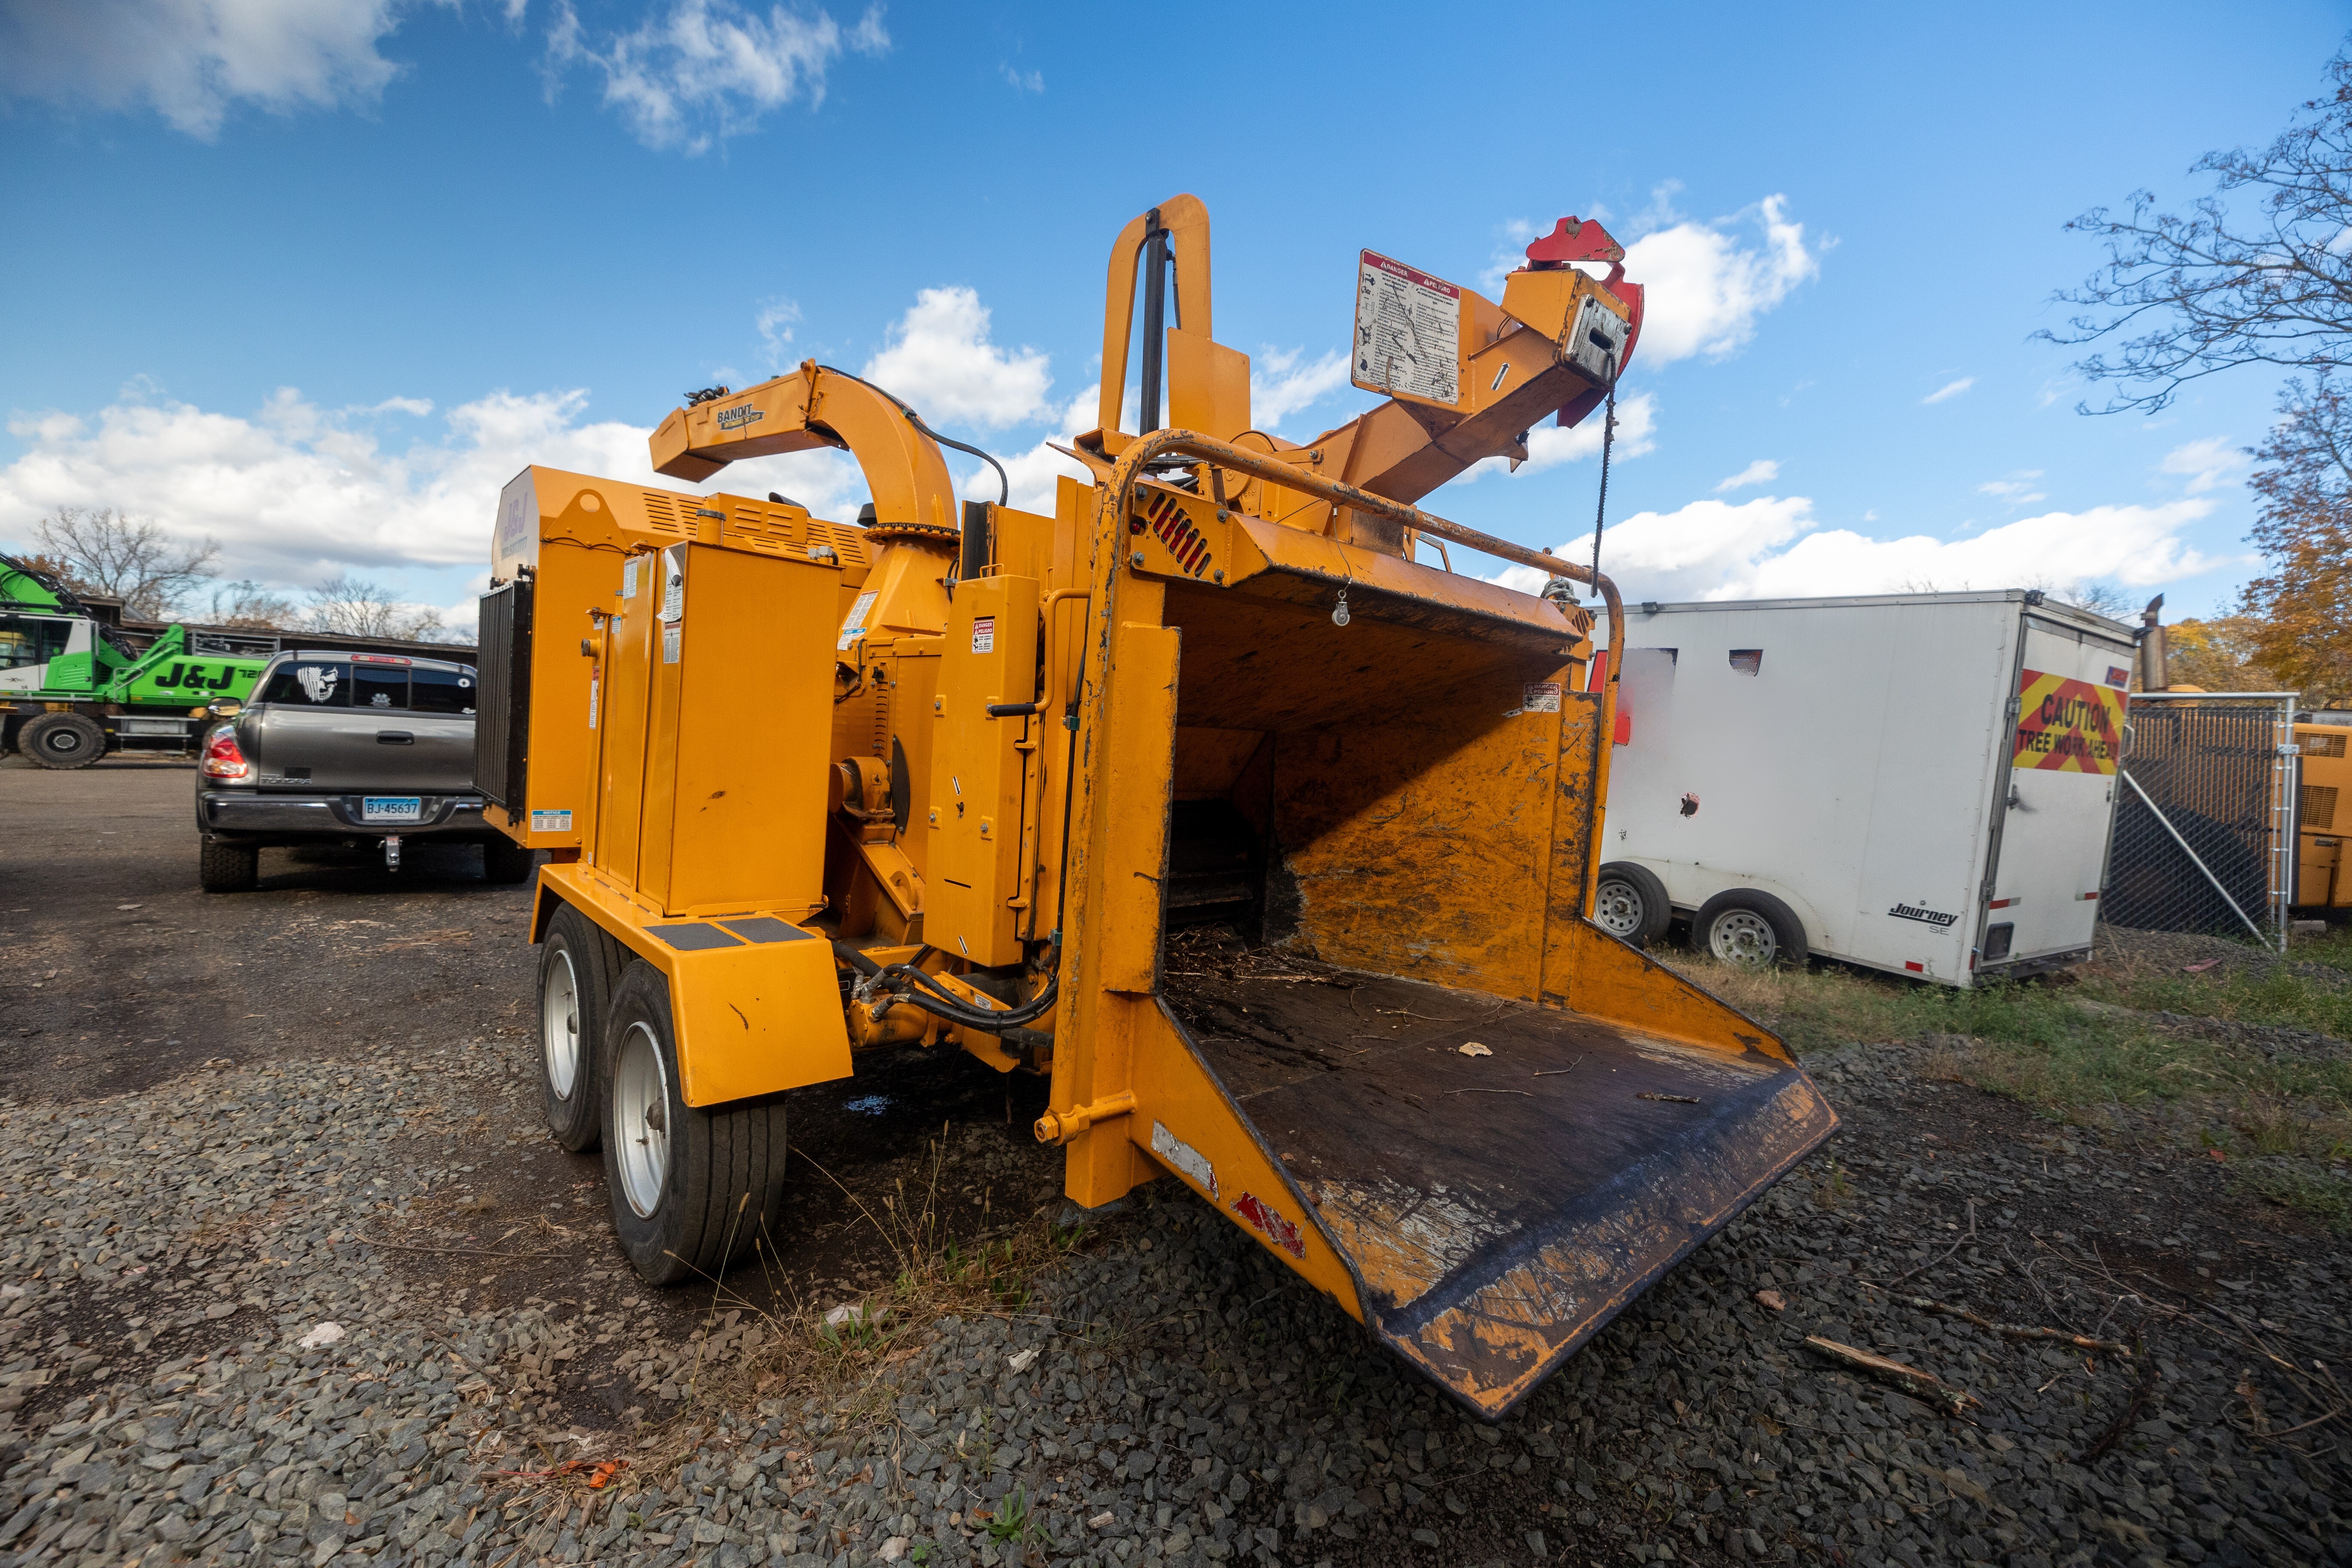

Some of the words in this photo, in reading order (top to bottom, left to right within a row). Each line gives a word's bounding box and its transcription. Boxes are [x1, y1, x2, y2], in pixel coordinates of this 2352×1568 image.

[1387, 264, 1408, 276] DANGER
[1430, 281, 1450, 293] PELIGRO
[717, 403, 753, 423] BANDIT
[155, 663, 236, 689] J&J
[2041, 694, 2111, 734] CAUTION
[2018, 729, 2052, 753] TREE
[2054, 734, 2086, 757] WORK
[1889, 903, 1959, 926] Journey
[1929, 926, 1949, 935] SE
